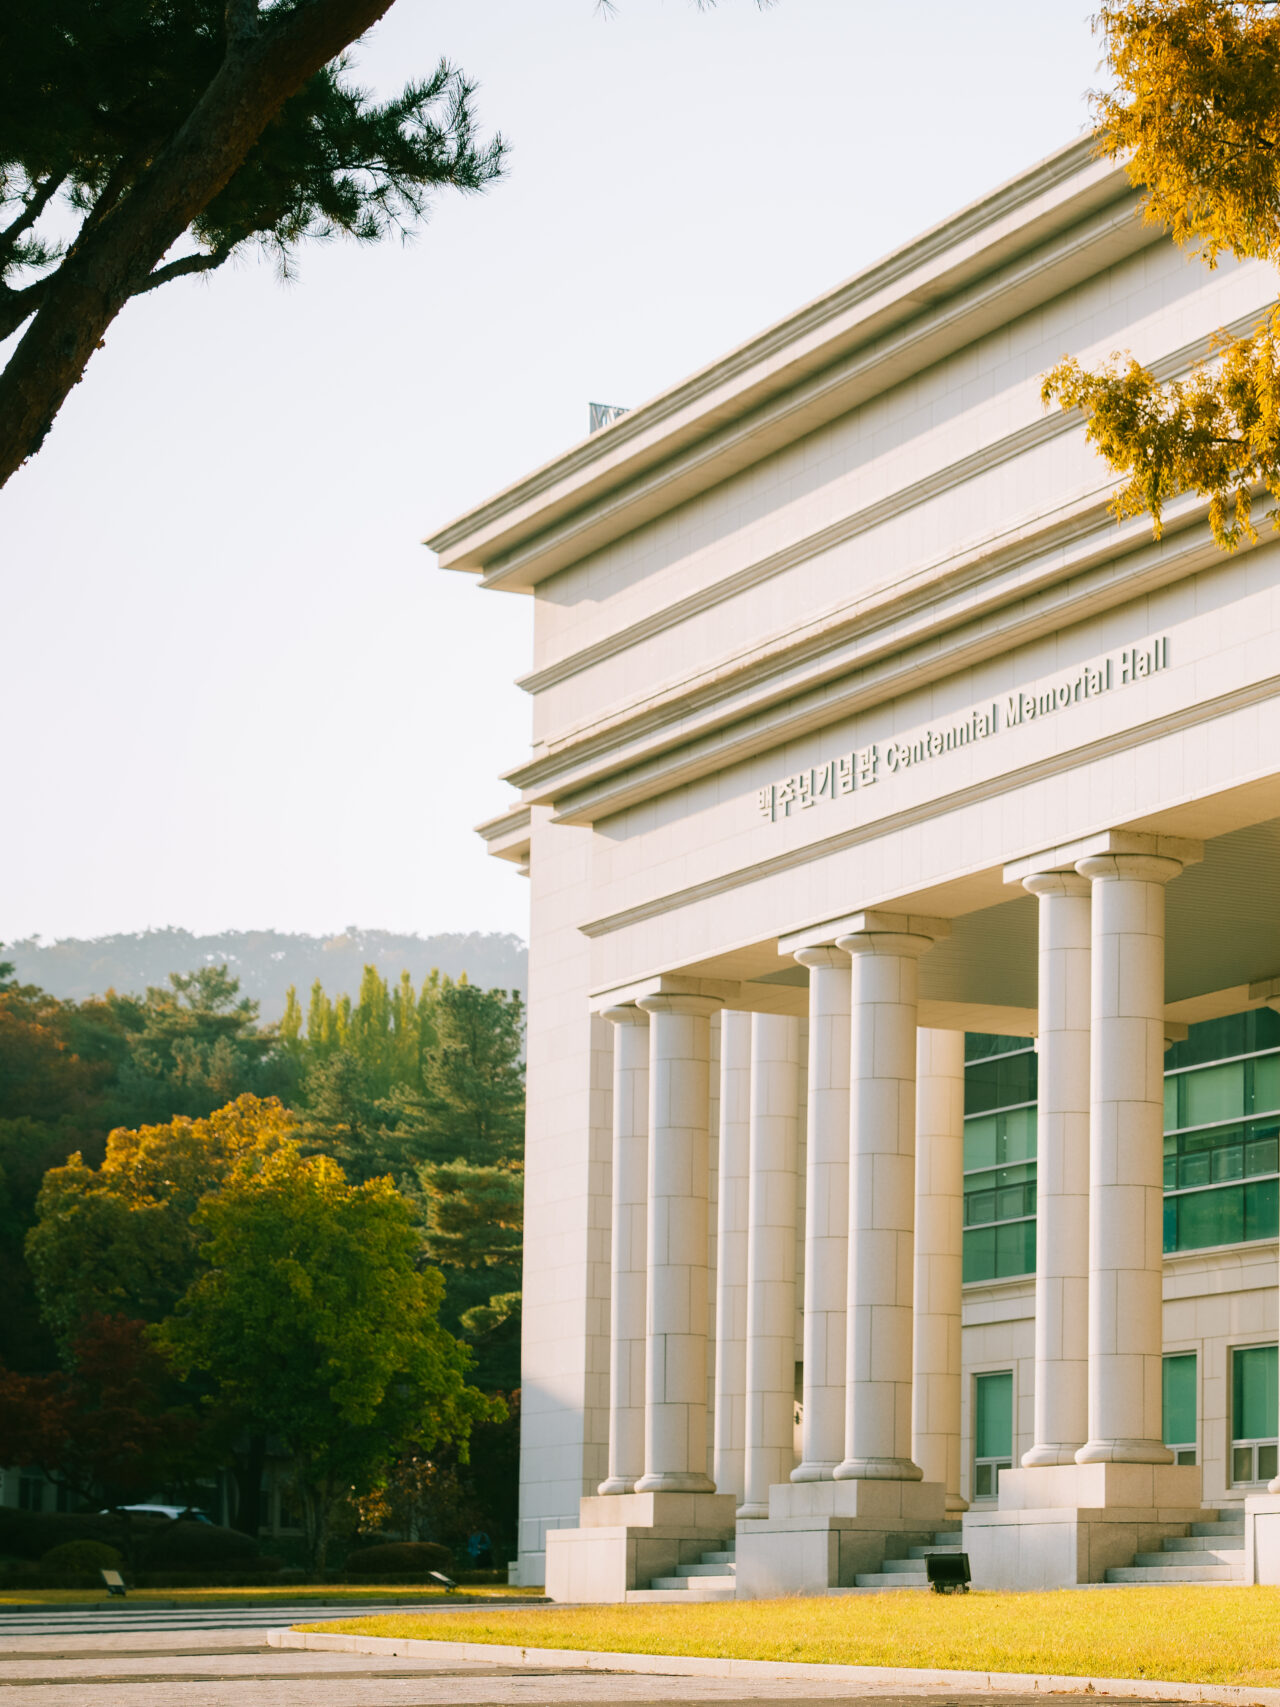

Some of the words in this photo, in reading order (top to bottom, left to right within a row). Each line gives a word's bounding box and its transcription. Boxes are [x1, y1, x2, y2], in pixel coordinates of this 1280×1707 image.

[757, 745, 879, 822] 백주년기념관
[886, 704, 996, 773] Centennial
[1005, 659, 1110, 728] Memorial
[1120, 636, 1167, 685] Hall
